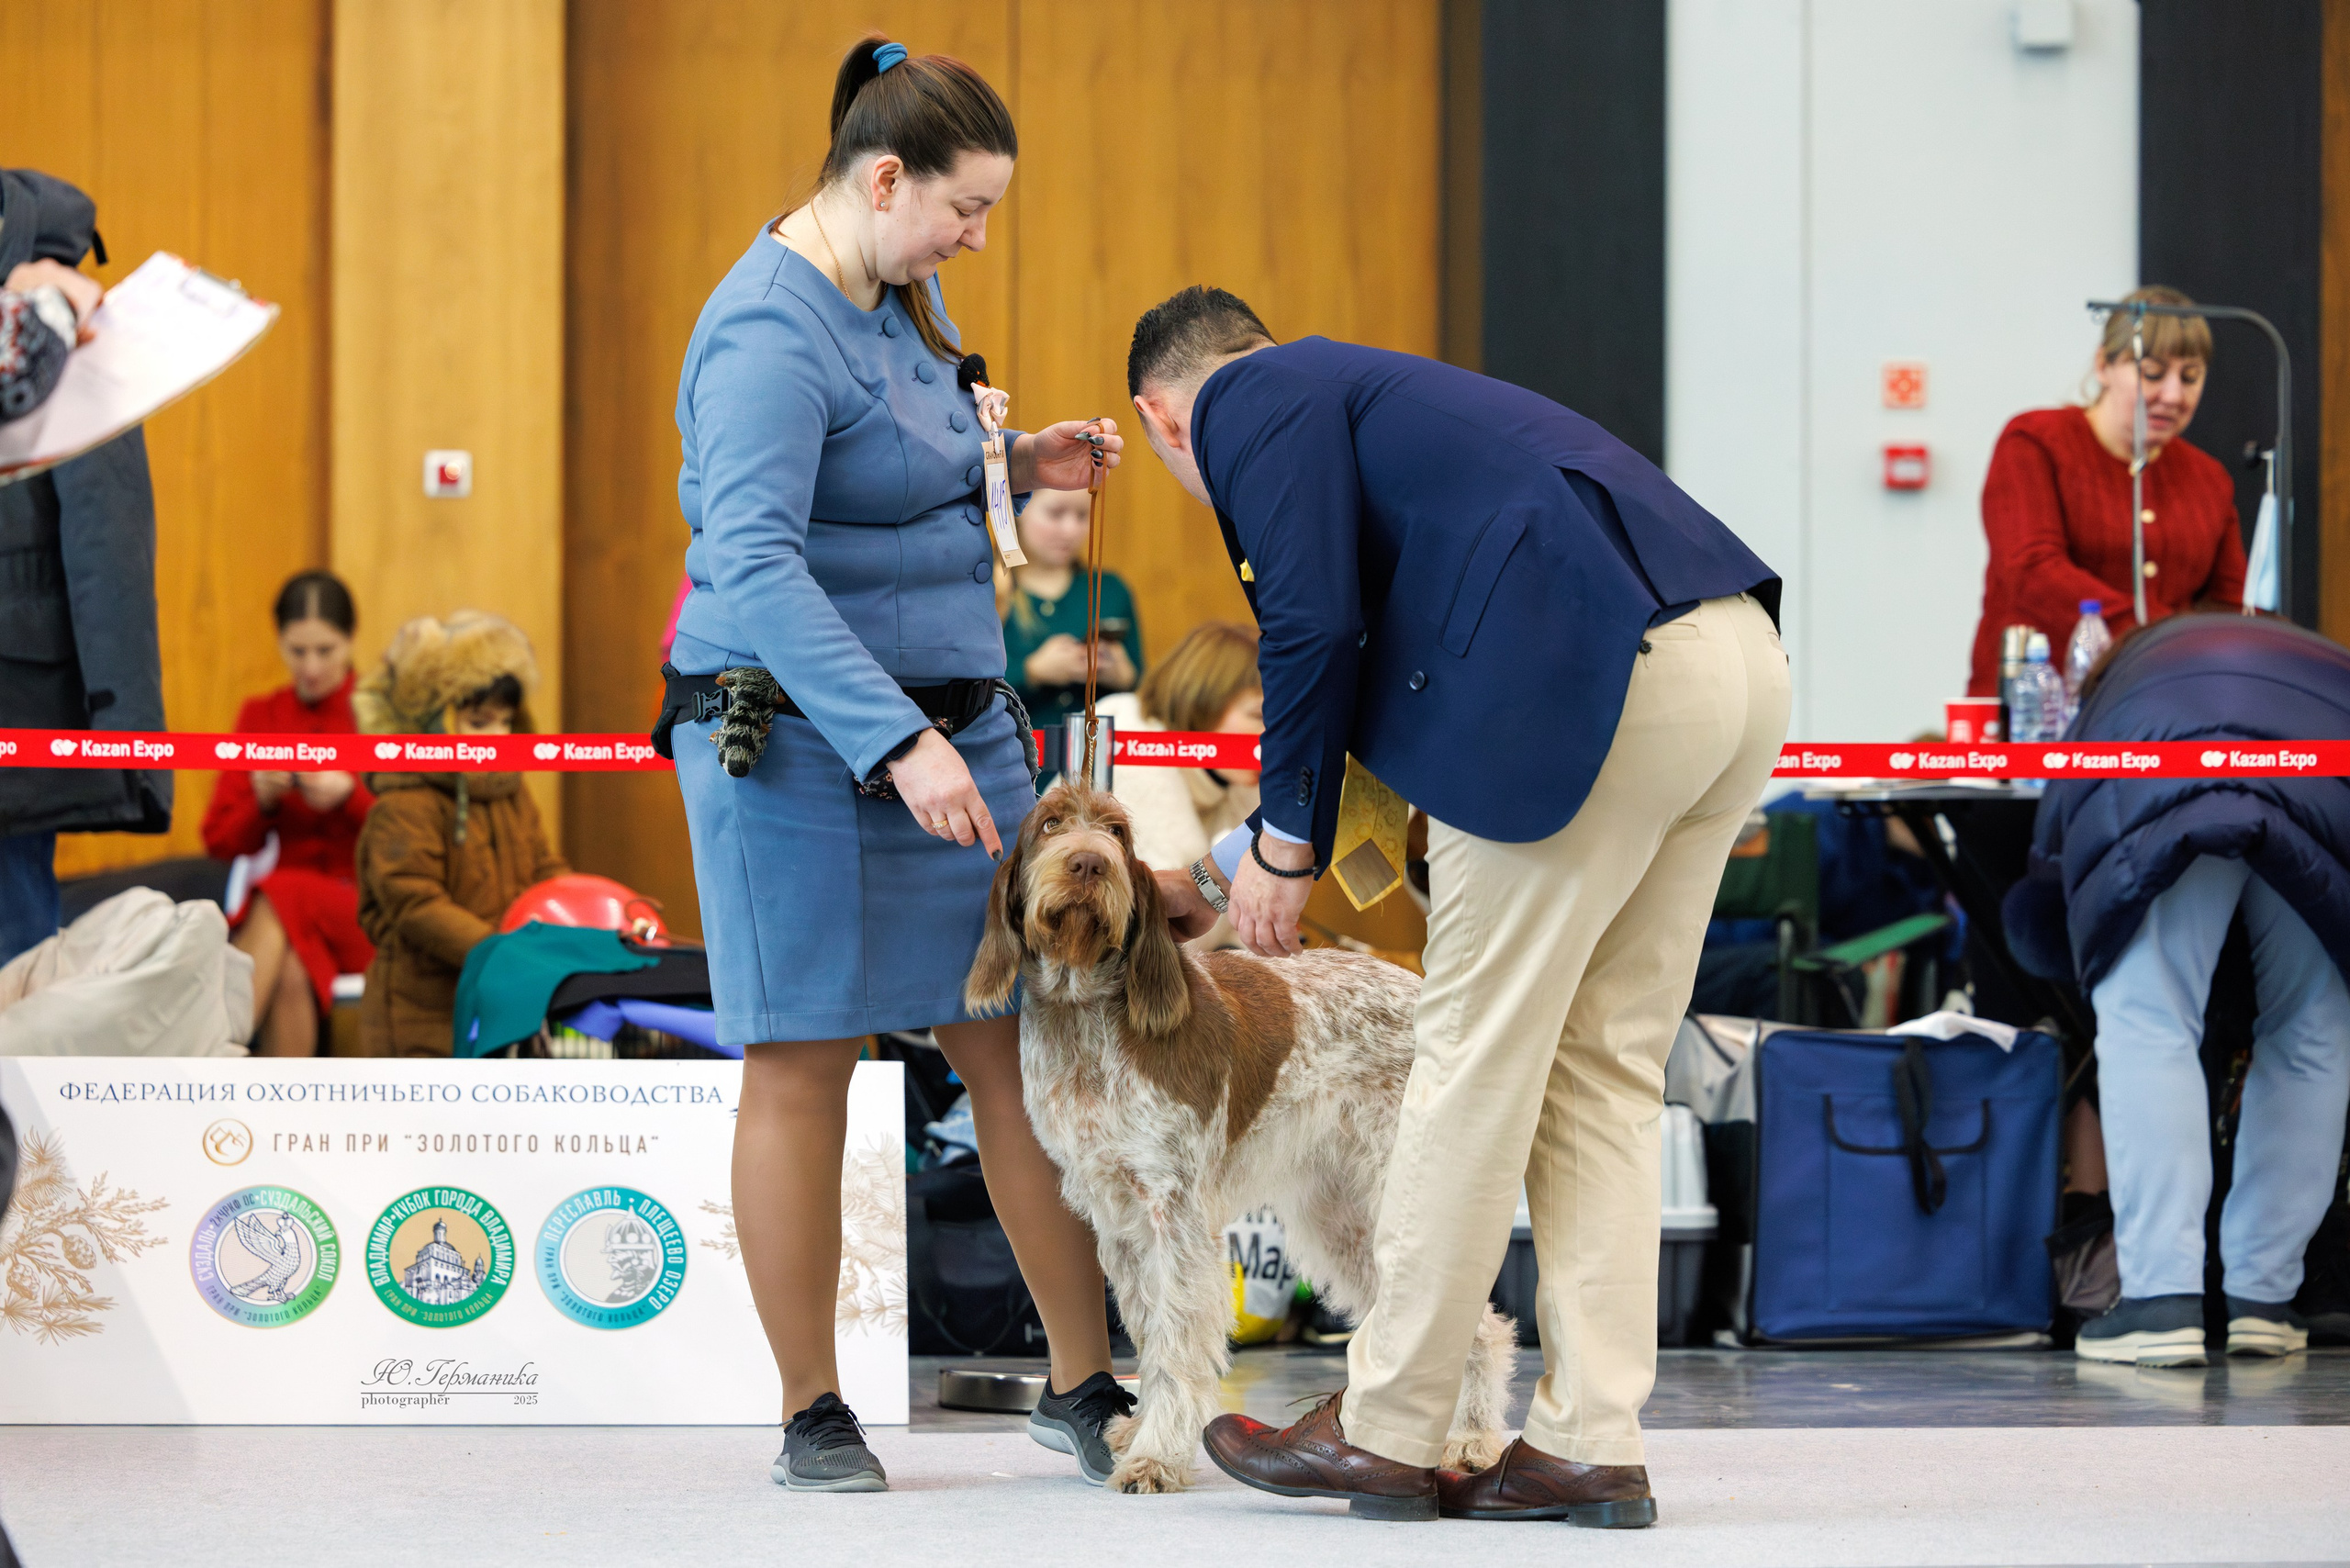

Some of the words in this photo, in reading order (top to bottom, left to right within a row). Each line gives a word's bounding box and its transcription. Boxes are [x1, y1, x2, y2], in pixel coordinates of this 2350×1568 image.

[0, 741, 17, 759] po
[82, 740, 130, 756] Kazan
[134, 740, 174, 761] Expo
[245, 742, 294, 760] Kazan
[297, 743, 337, 764] Expo
[405, 743, 453, 759] Kazan
[456, 743, 497, 764] Expo
[564, 743, 612, 760] Kazan
[615, 743, 655, 764] Expo
[1126, 739, 1175, 756] Kazan
[1178, 740, 1217, 761] Expo
[2230, 750, 2277, 767] Kazan
[2279, 749, 2318, 770] Expo
[1774, 755, 1800, 768] zan
[1802, 751, 1841, 772] Expo
[1919, 752, 1966, 769] Kazan
[1968, 751, 2008, 772] Expo
[2072, 752, 2119, 769] Kazan
[2121, 751, 2160, 772] Expo
[60, 1081, 236, 1105] ФЕДЕРАЦИЯ
[246, 1082, 462, 1103] ОХОТНИЧЬЕГО
[471, 1083, 723, 1105] СОБАКОВОДСТВА
[274, 1133, 330, 1153] ГРАН
[346, 1133, 389, 1153] ПРИ
[404, 1134, 539, 1153] "ЗОЛОТОГО
[554, 1135, 659, 1156] КОЛЬЦА"
[543, 1190, 621, 1242] ПЕРЕСЛАВЛЬ
[195, 1230, 217, 1282] СУЗДАЛЬ
[260, 1190, 335, 1242] СУЗДАЛЬСКИЙ
[317, 1243, 337, 1282] СОКОЛ
[368, 1215, 397, 1287] ВЛАДИМИР
[393, 1191, 431, 1221] КУБОК
[434, 1189, 484, 1217] ГОРОДА
[479, 1209, 512, 1285] ВЛАДИМИРА
[638, 1198, 684, 1264] ПЛЕЩЕЕВО
[648, 1270, 682, 1311] ОЗЕРО
